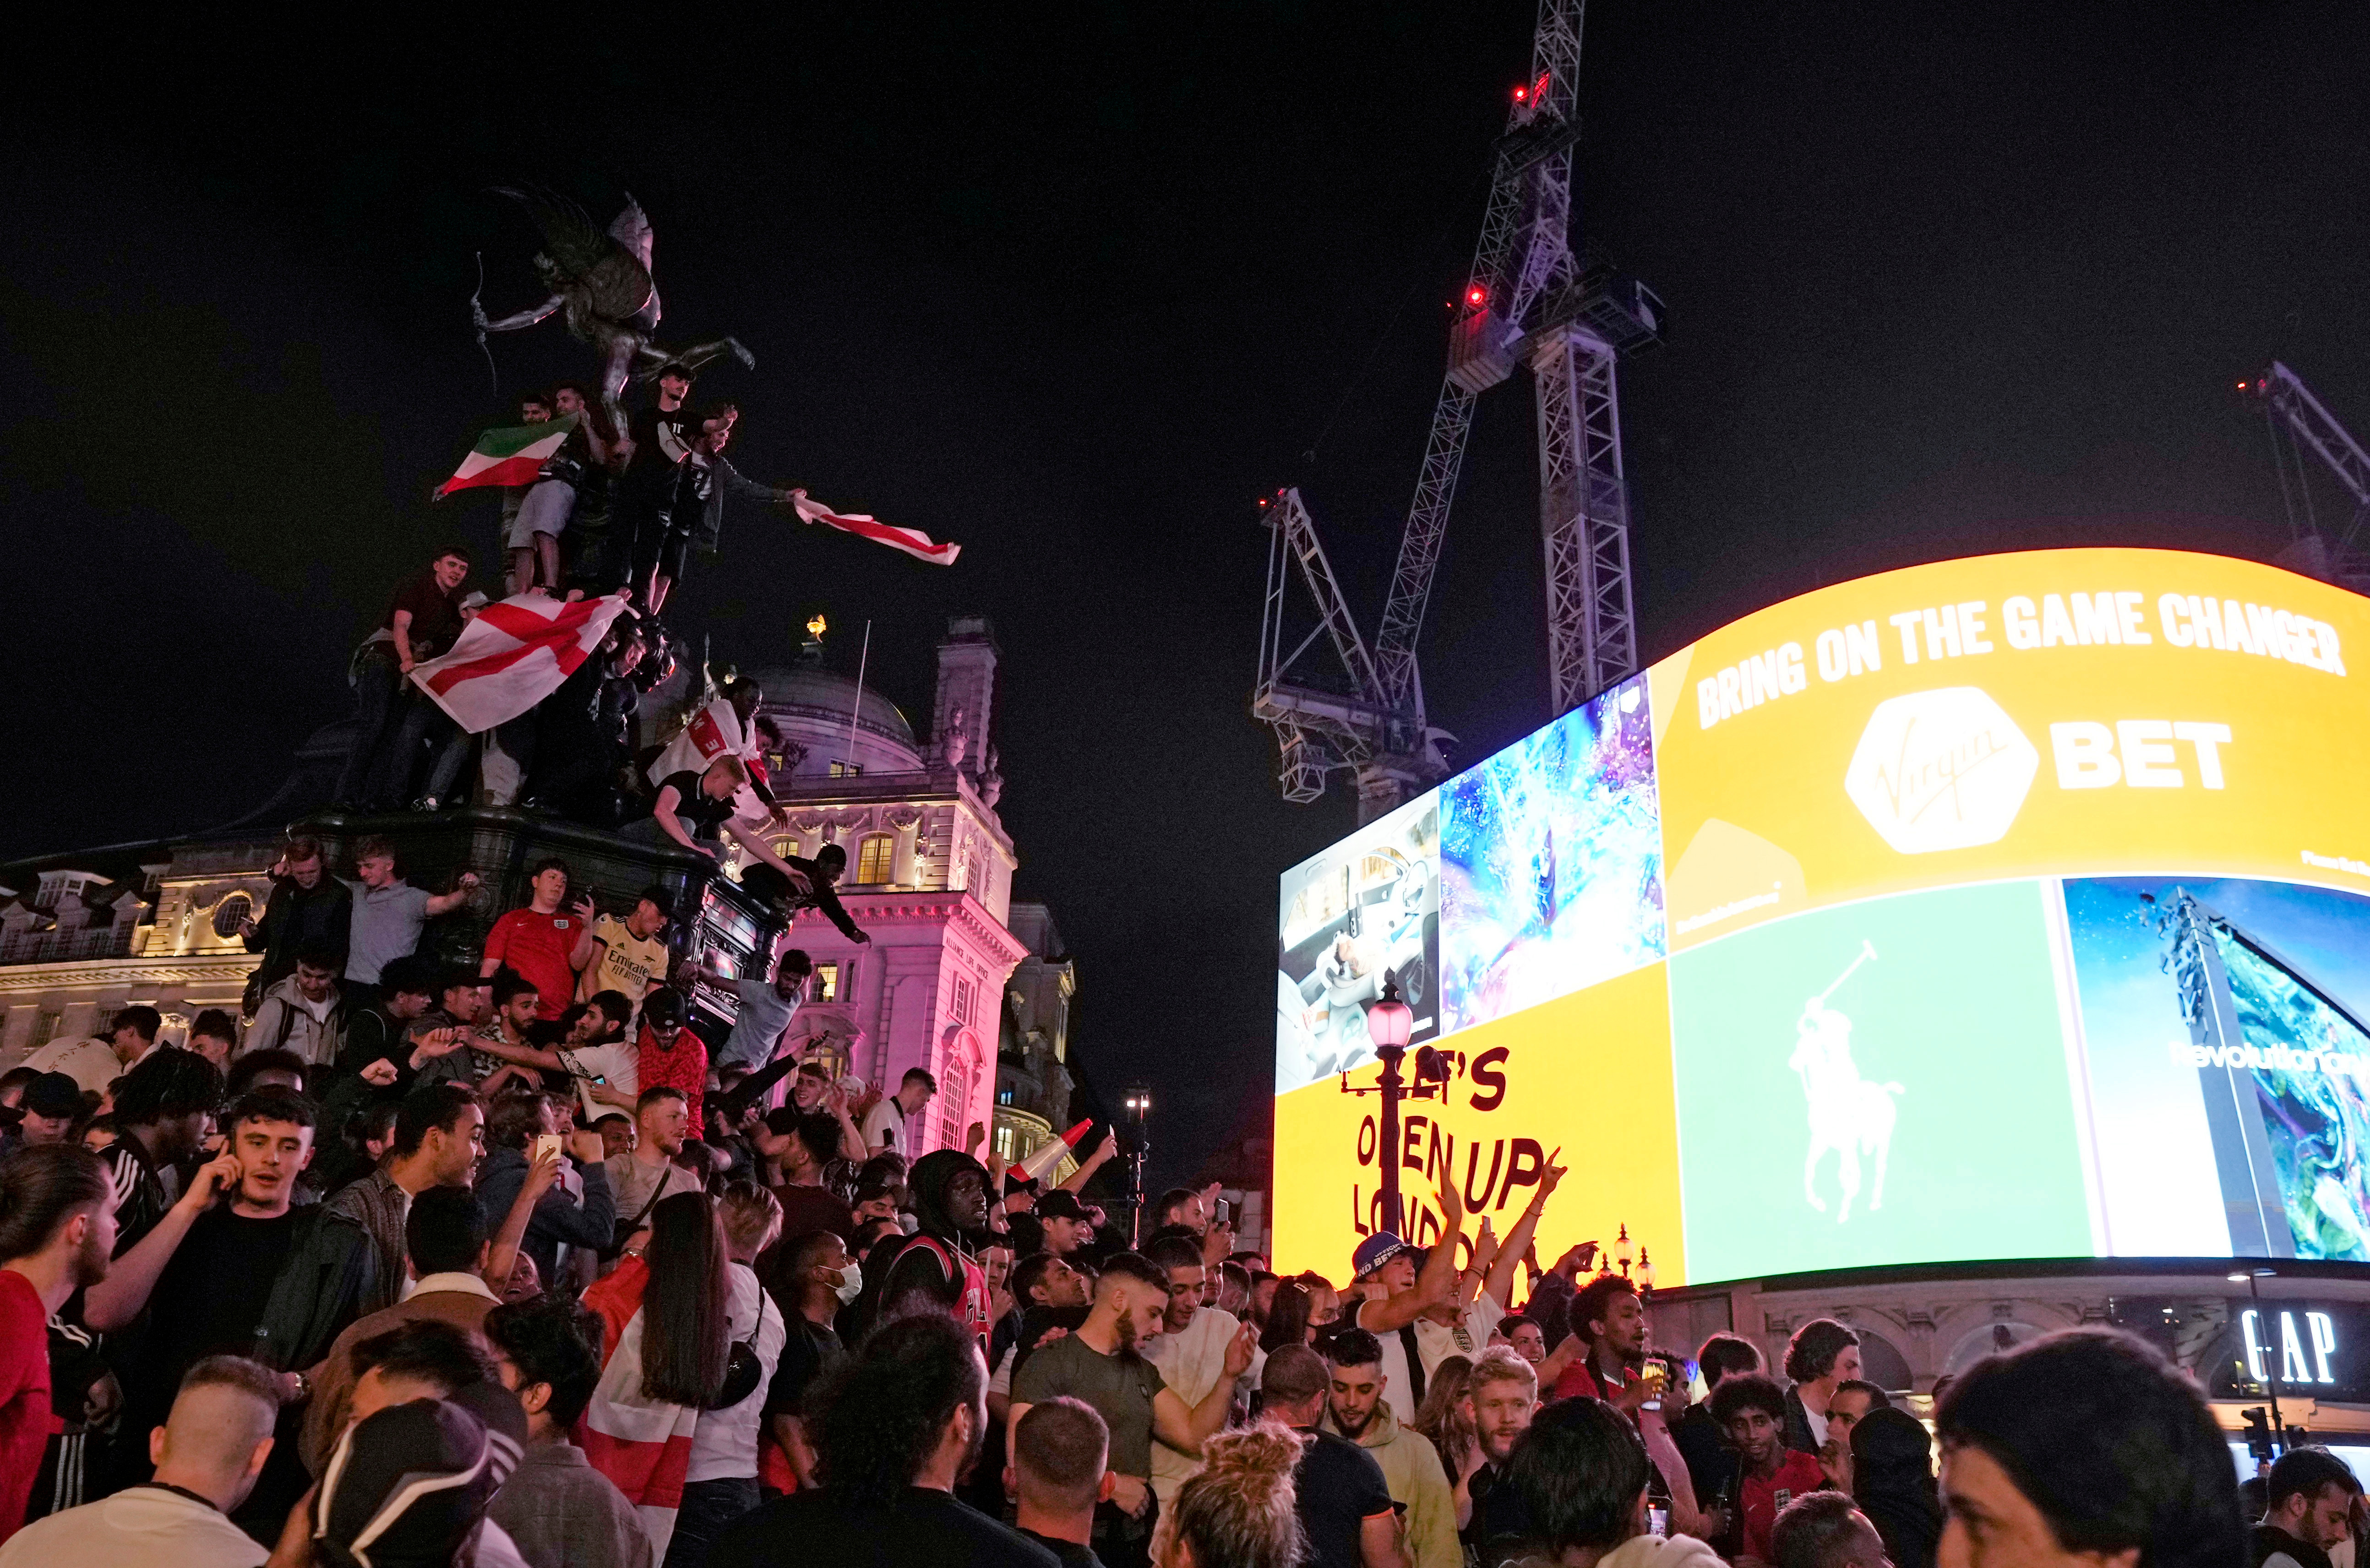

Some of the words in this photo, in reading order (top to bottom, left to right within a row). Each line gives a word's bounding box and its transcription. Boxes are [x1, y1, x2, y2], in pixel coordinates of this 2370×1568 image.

[1697, 642, 1807, 730] BRING
[1816, 620, 1881, 682] ON
[1889, 600, 1993, 665] THE
[2002, 591, 2152, 650] GAME
[2158, 593, 2346, 677] CHANGER
[1874, 716, 2009, 825] Virgin
[2049, 720, 2232, 789] BET
[1357, 1115, 1453, 1183] OEN
[1464, 1138, 1544, 1214] UP
[2241, 1309, 2335, 1383] GAP
